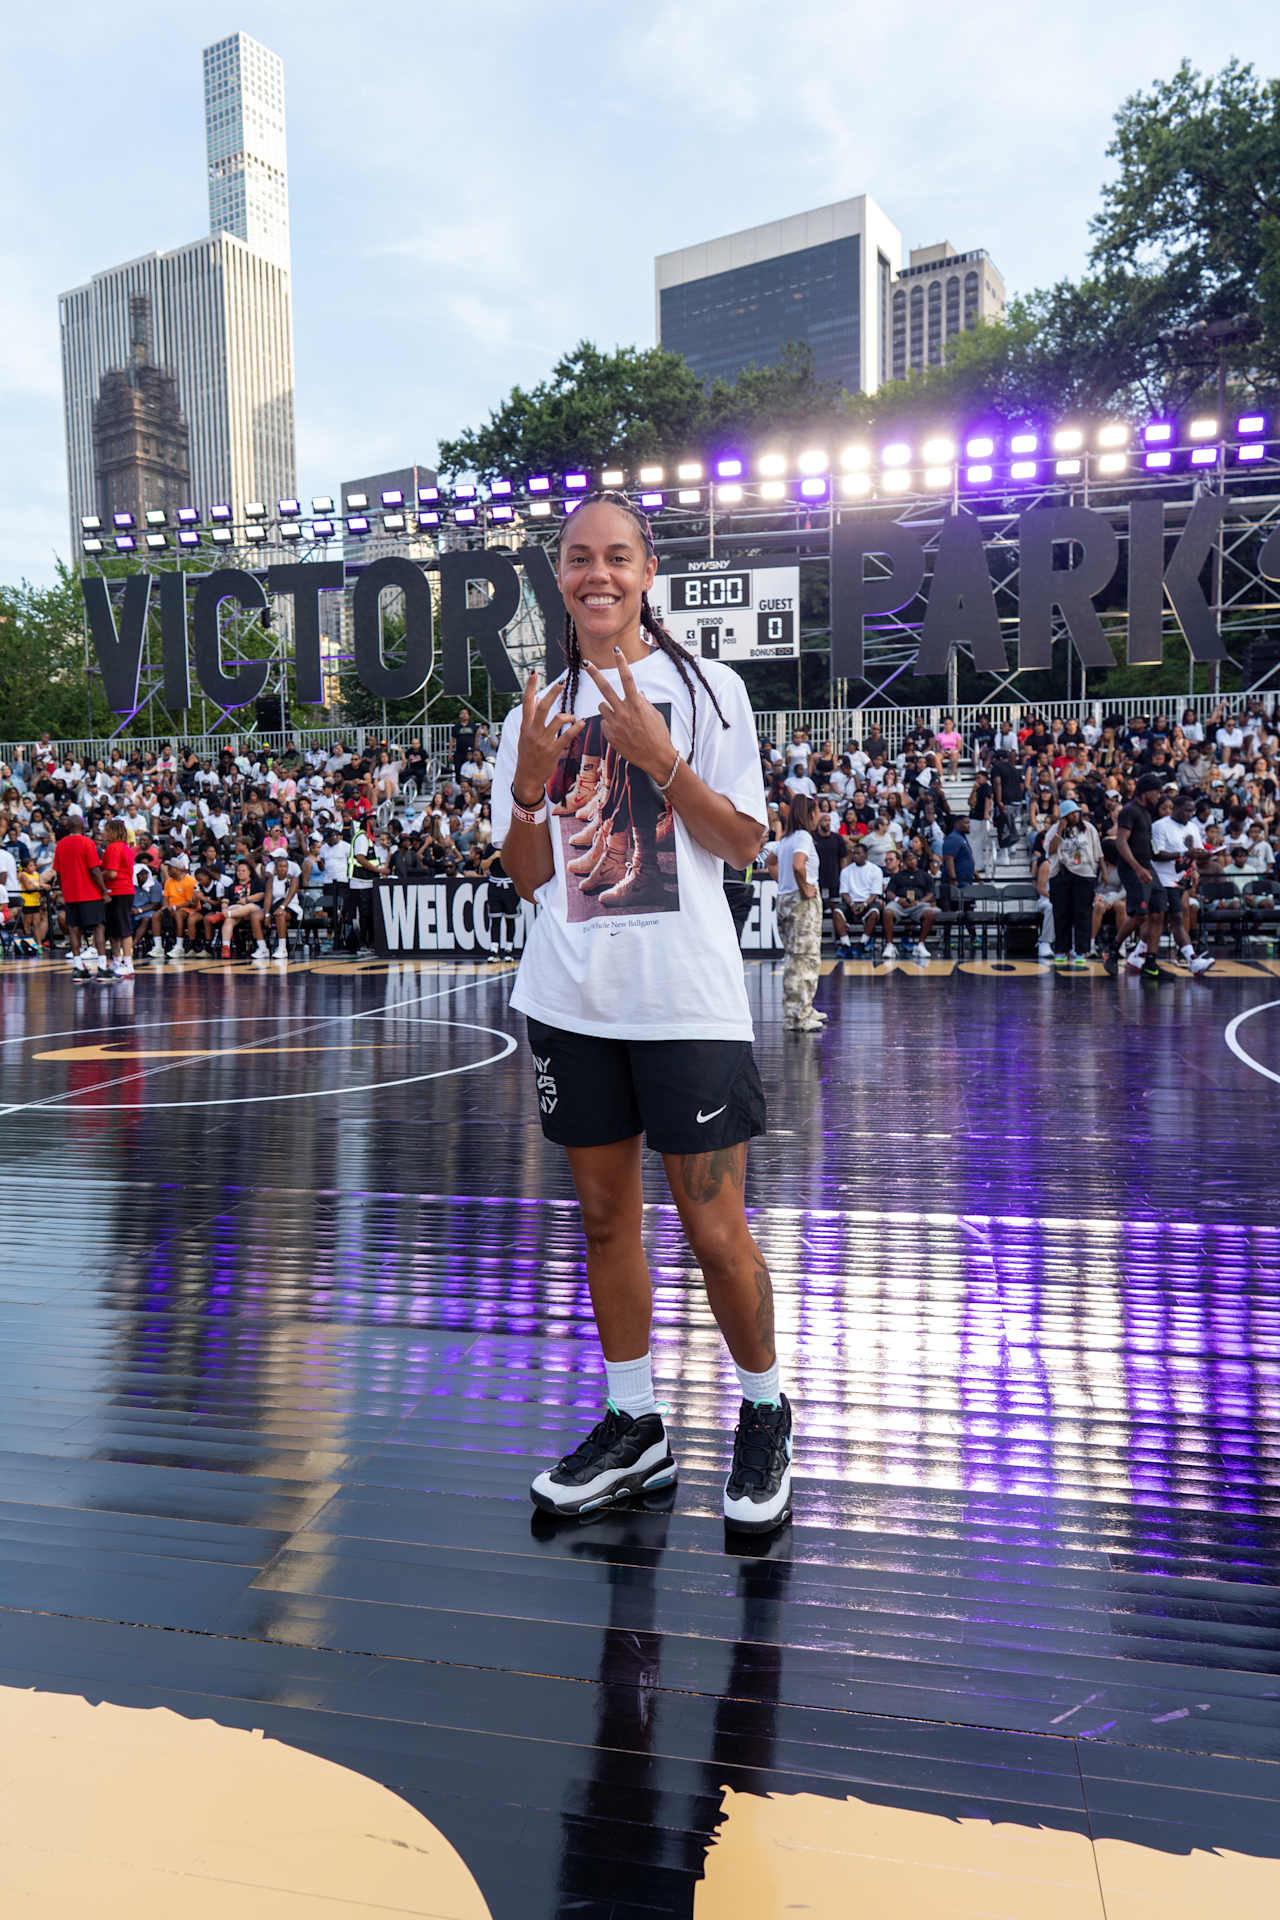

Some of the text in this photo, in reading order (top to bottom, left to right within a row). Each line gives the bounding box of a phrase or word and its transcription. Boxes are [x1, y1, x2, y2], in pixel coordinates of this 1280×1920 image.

[685, 578, 743, 606] 8:00
[833, 496, 1231, 678] PARK
[759, 598, 793, 611] GUEST
[697, 617, 724, 625] PERIOD
[768, 617, 782, 639] 0
[750, 648, 776, 657] BONUS
[379, 882, 541, 950] WELCO
